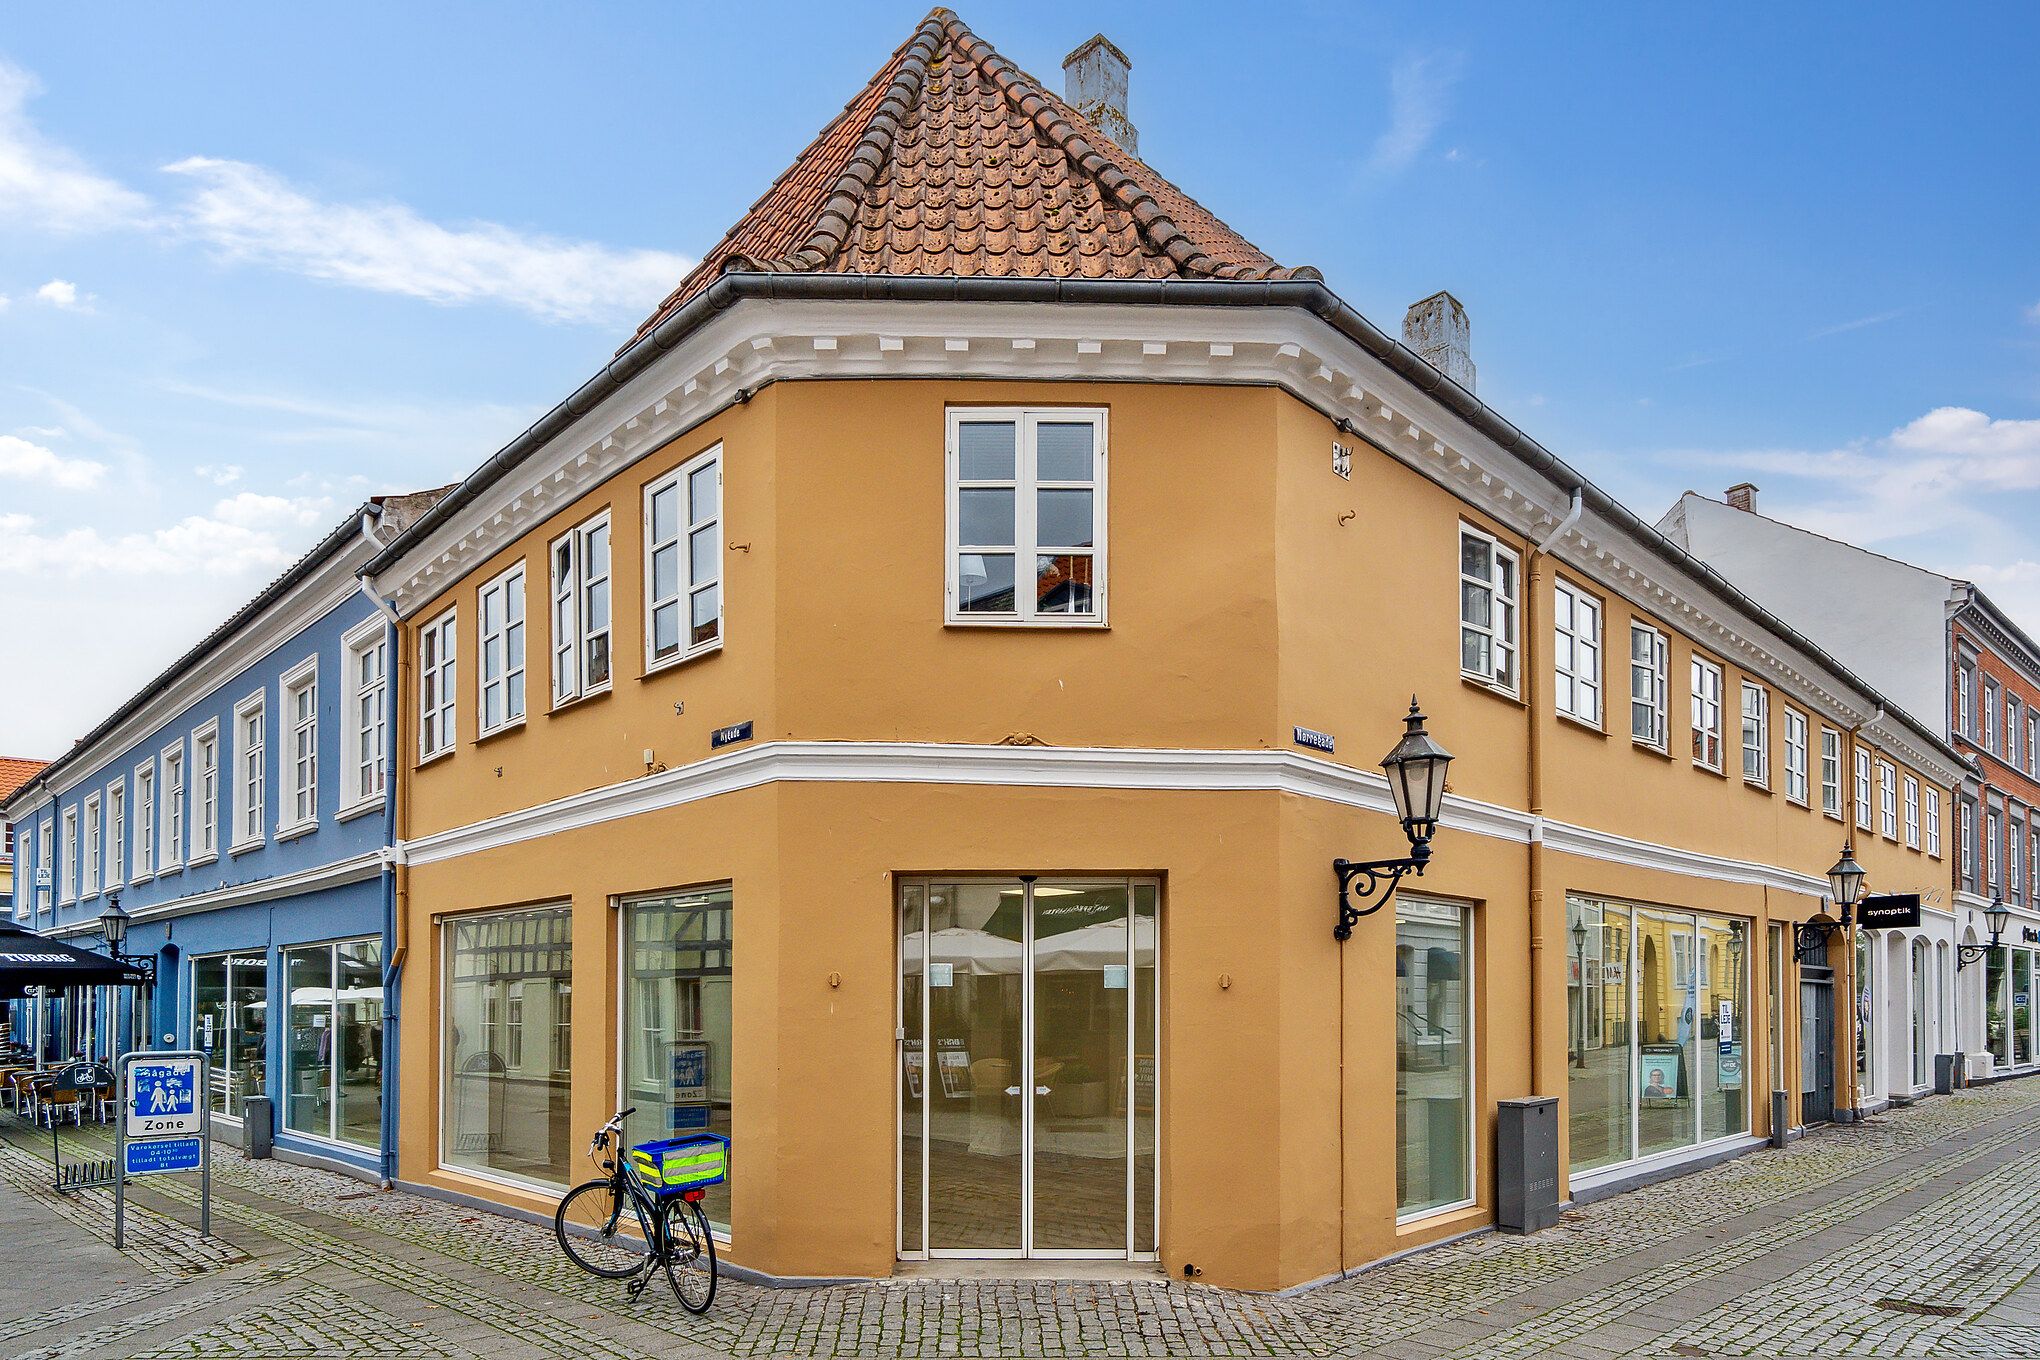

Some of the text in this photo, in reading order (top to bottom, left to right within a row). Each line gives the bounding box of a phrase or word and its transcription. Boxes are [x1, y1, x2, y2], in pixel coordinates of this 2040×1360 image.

[1867, 907, 1911, 916] synoptik
[0, 953, 76, 962] TUBORG
[144, 1120, 185, 1131] Zone
